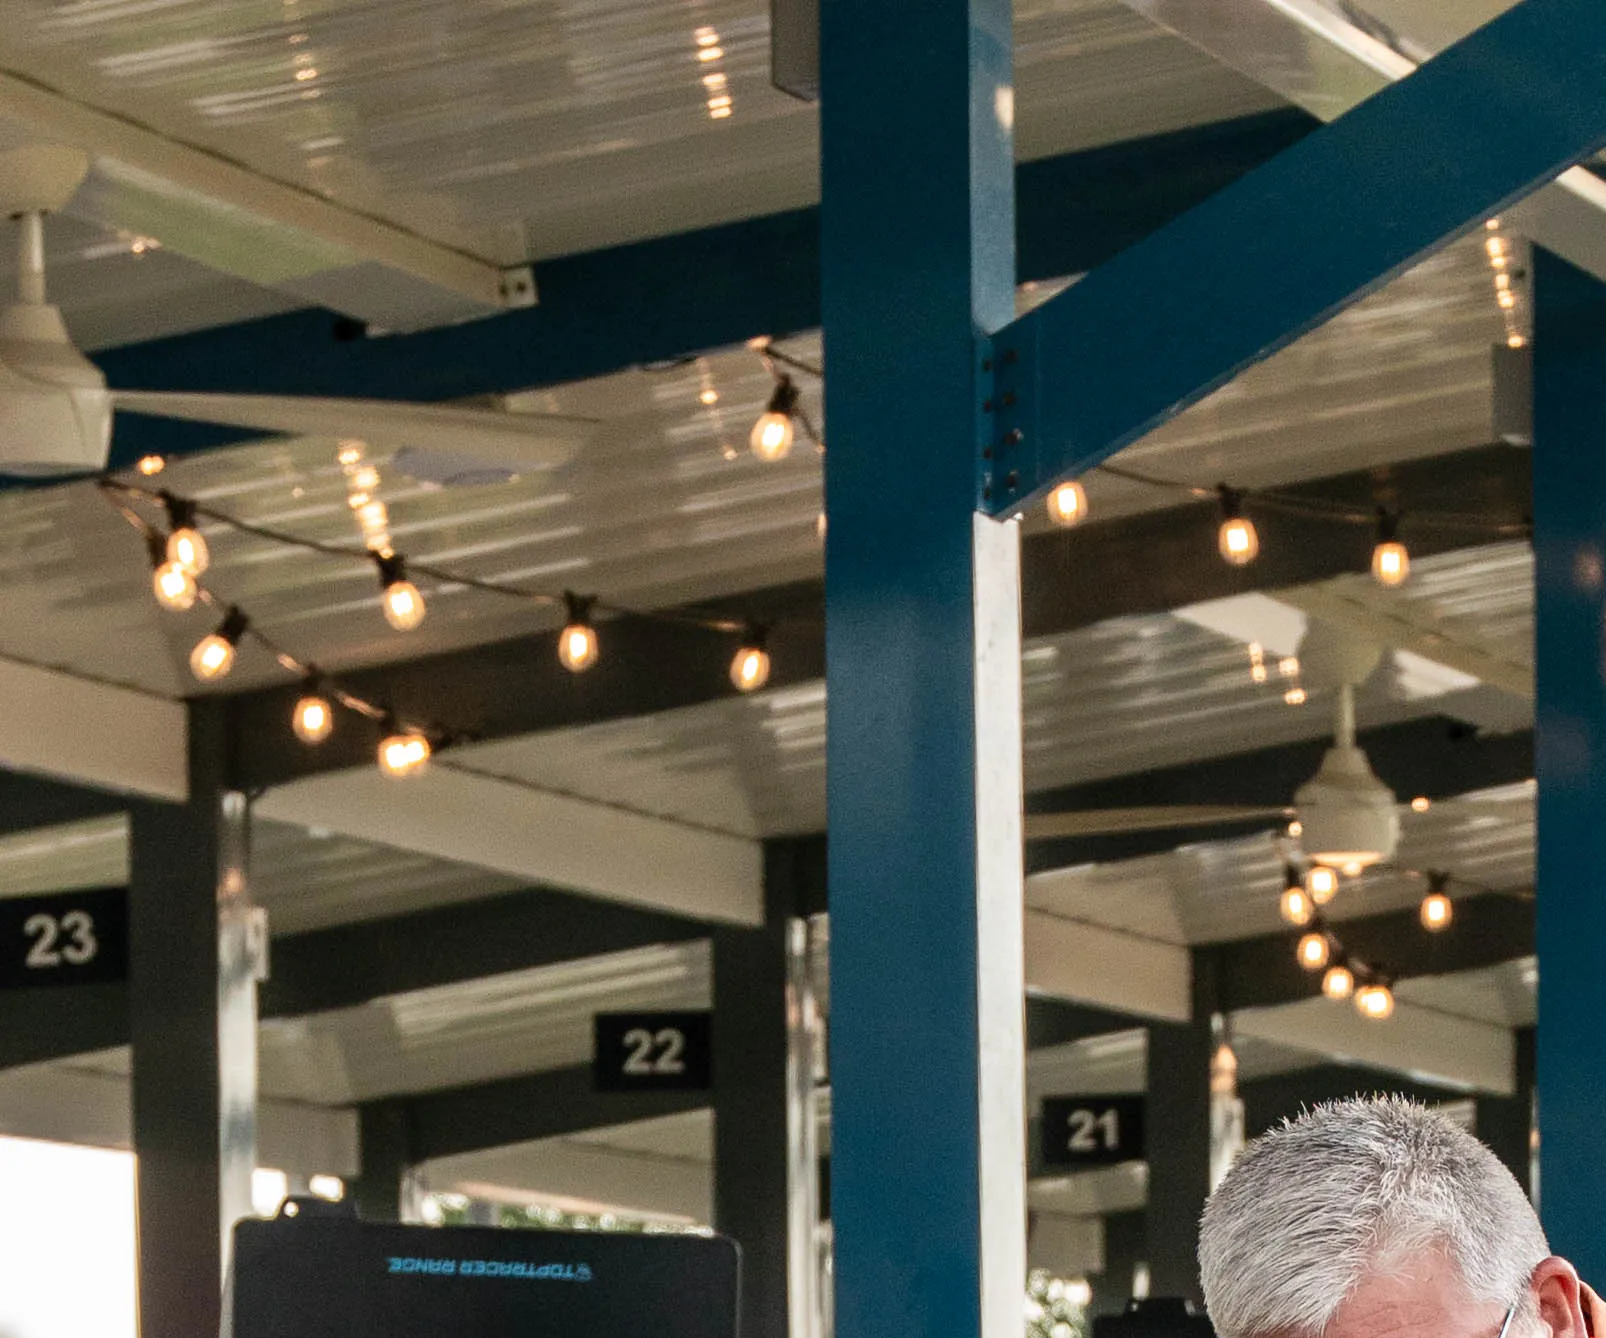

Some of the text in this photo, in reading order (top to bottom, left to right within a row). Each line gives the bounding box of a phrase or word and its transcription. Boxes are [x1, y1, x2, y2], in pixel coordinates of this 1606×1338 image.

[24, 910, 97, 968] 23
[622, 1029, 685, 1075] 22
[1067, 1108, 1119, 1151] 21
[387, 1256, 575, 1281] TOPTRACER RANGE
